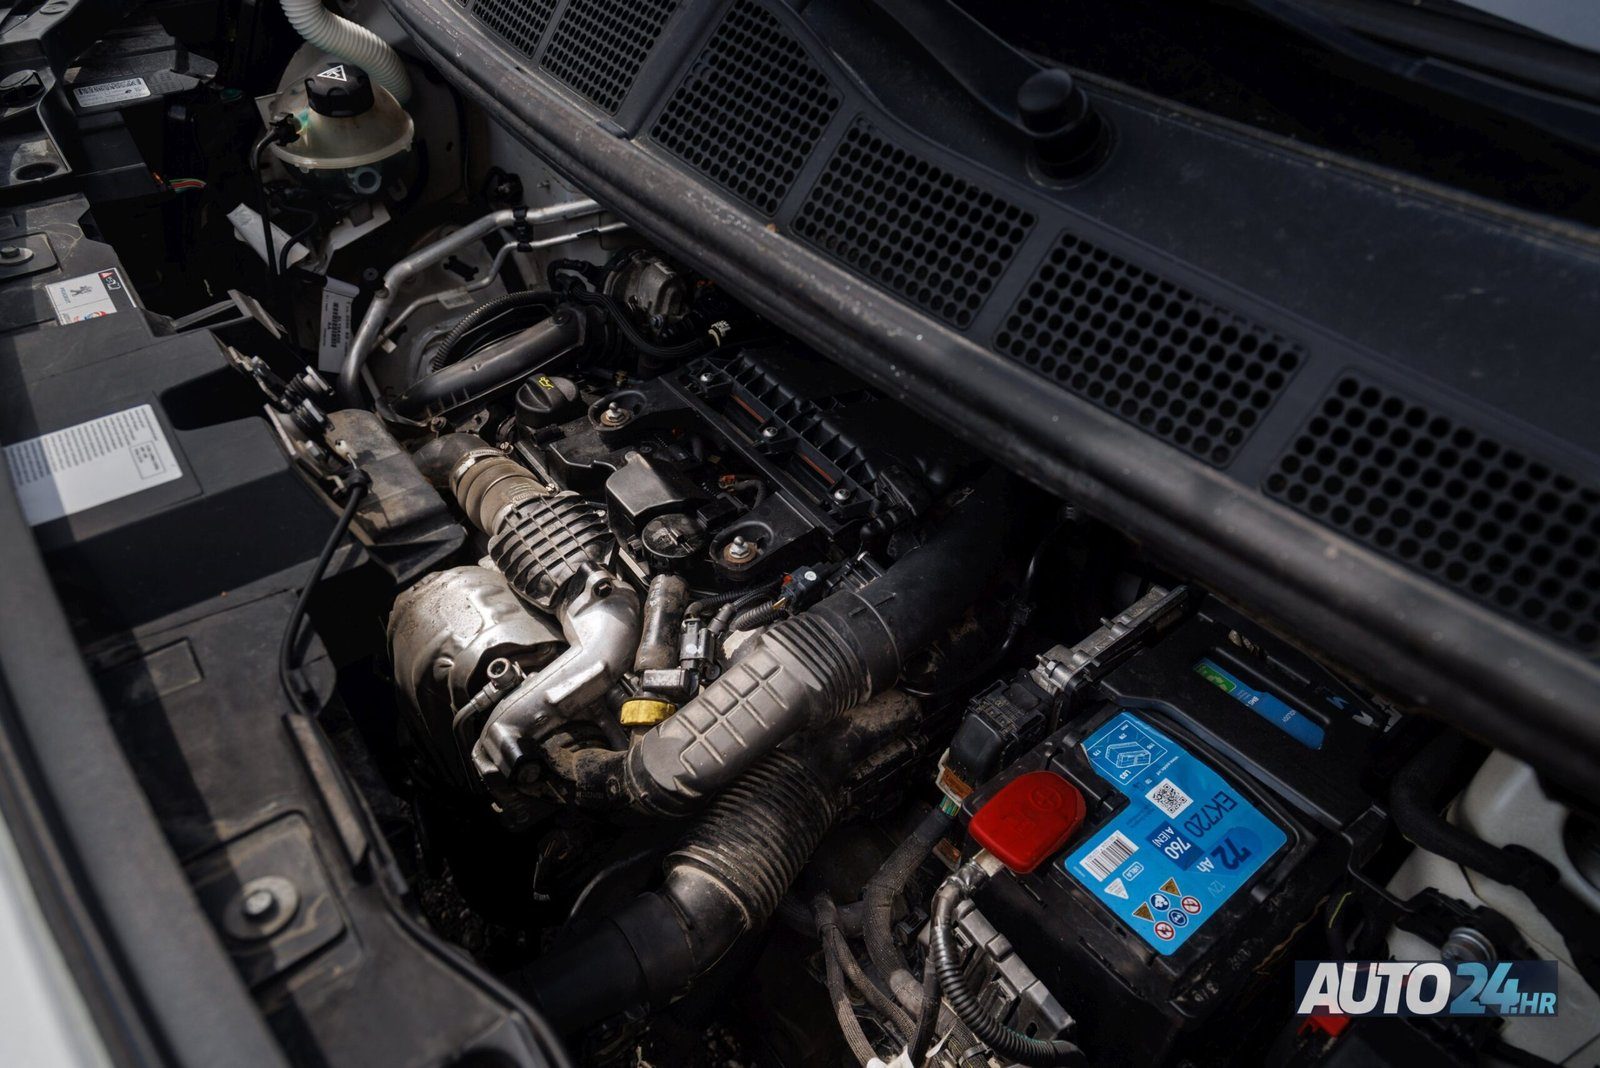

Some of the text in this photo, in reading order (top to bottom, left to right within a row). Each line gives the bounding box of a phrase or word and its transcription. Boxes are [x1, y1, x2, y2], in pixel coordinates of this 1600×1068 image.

[1184, 790, 1238, 838] EK720
[1164, 836, 1192, 860] 760
[1196, 837, 1253, 873] 72 Ah
[1207, 879, 1226, 897] 12V
